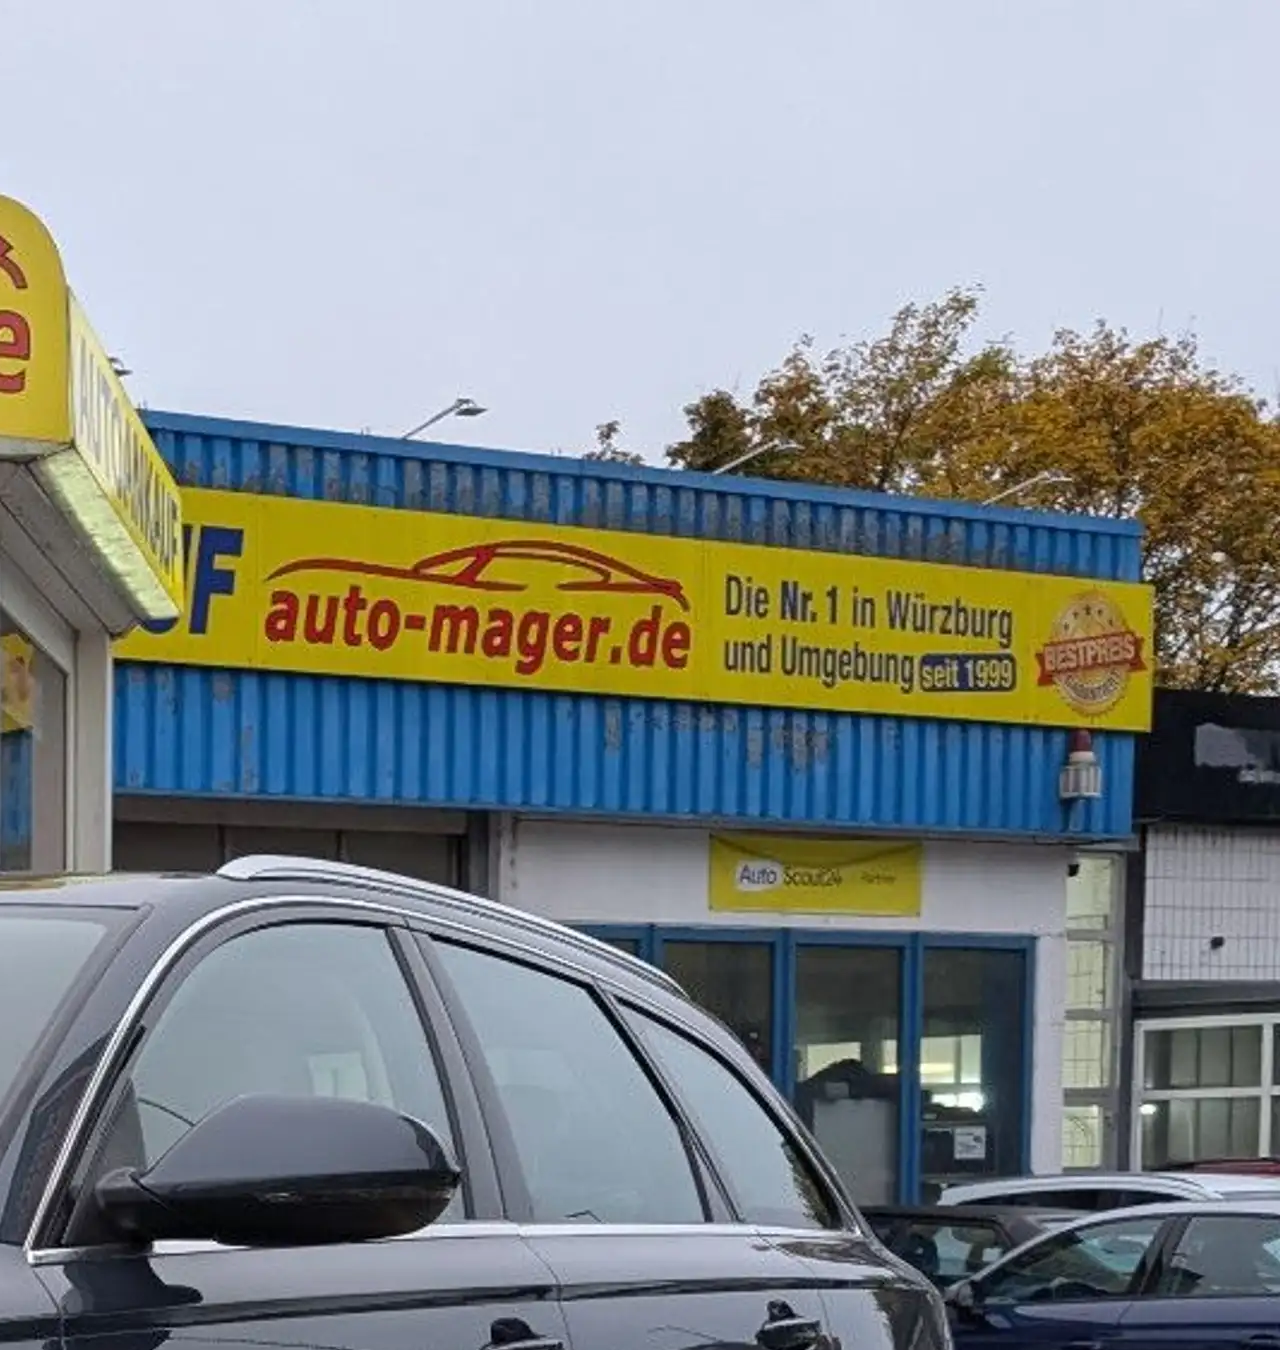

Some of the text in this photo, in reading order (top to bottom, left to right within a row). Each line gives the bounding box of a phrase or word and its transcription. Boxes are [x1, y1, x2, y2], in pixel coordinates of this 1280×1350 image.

[265, 585, 691, 675] auto-mager.de
[725, 574, 1013, 649] Die Nr. 1 in Würzburg
[724, 633, 1014, 694] und Umgebung seit 1999
[739, 864, 778, 885] Auto
